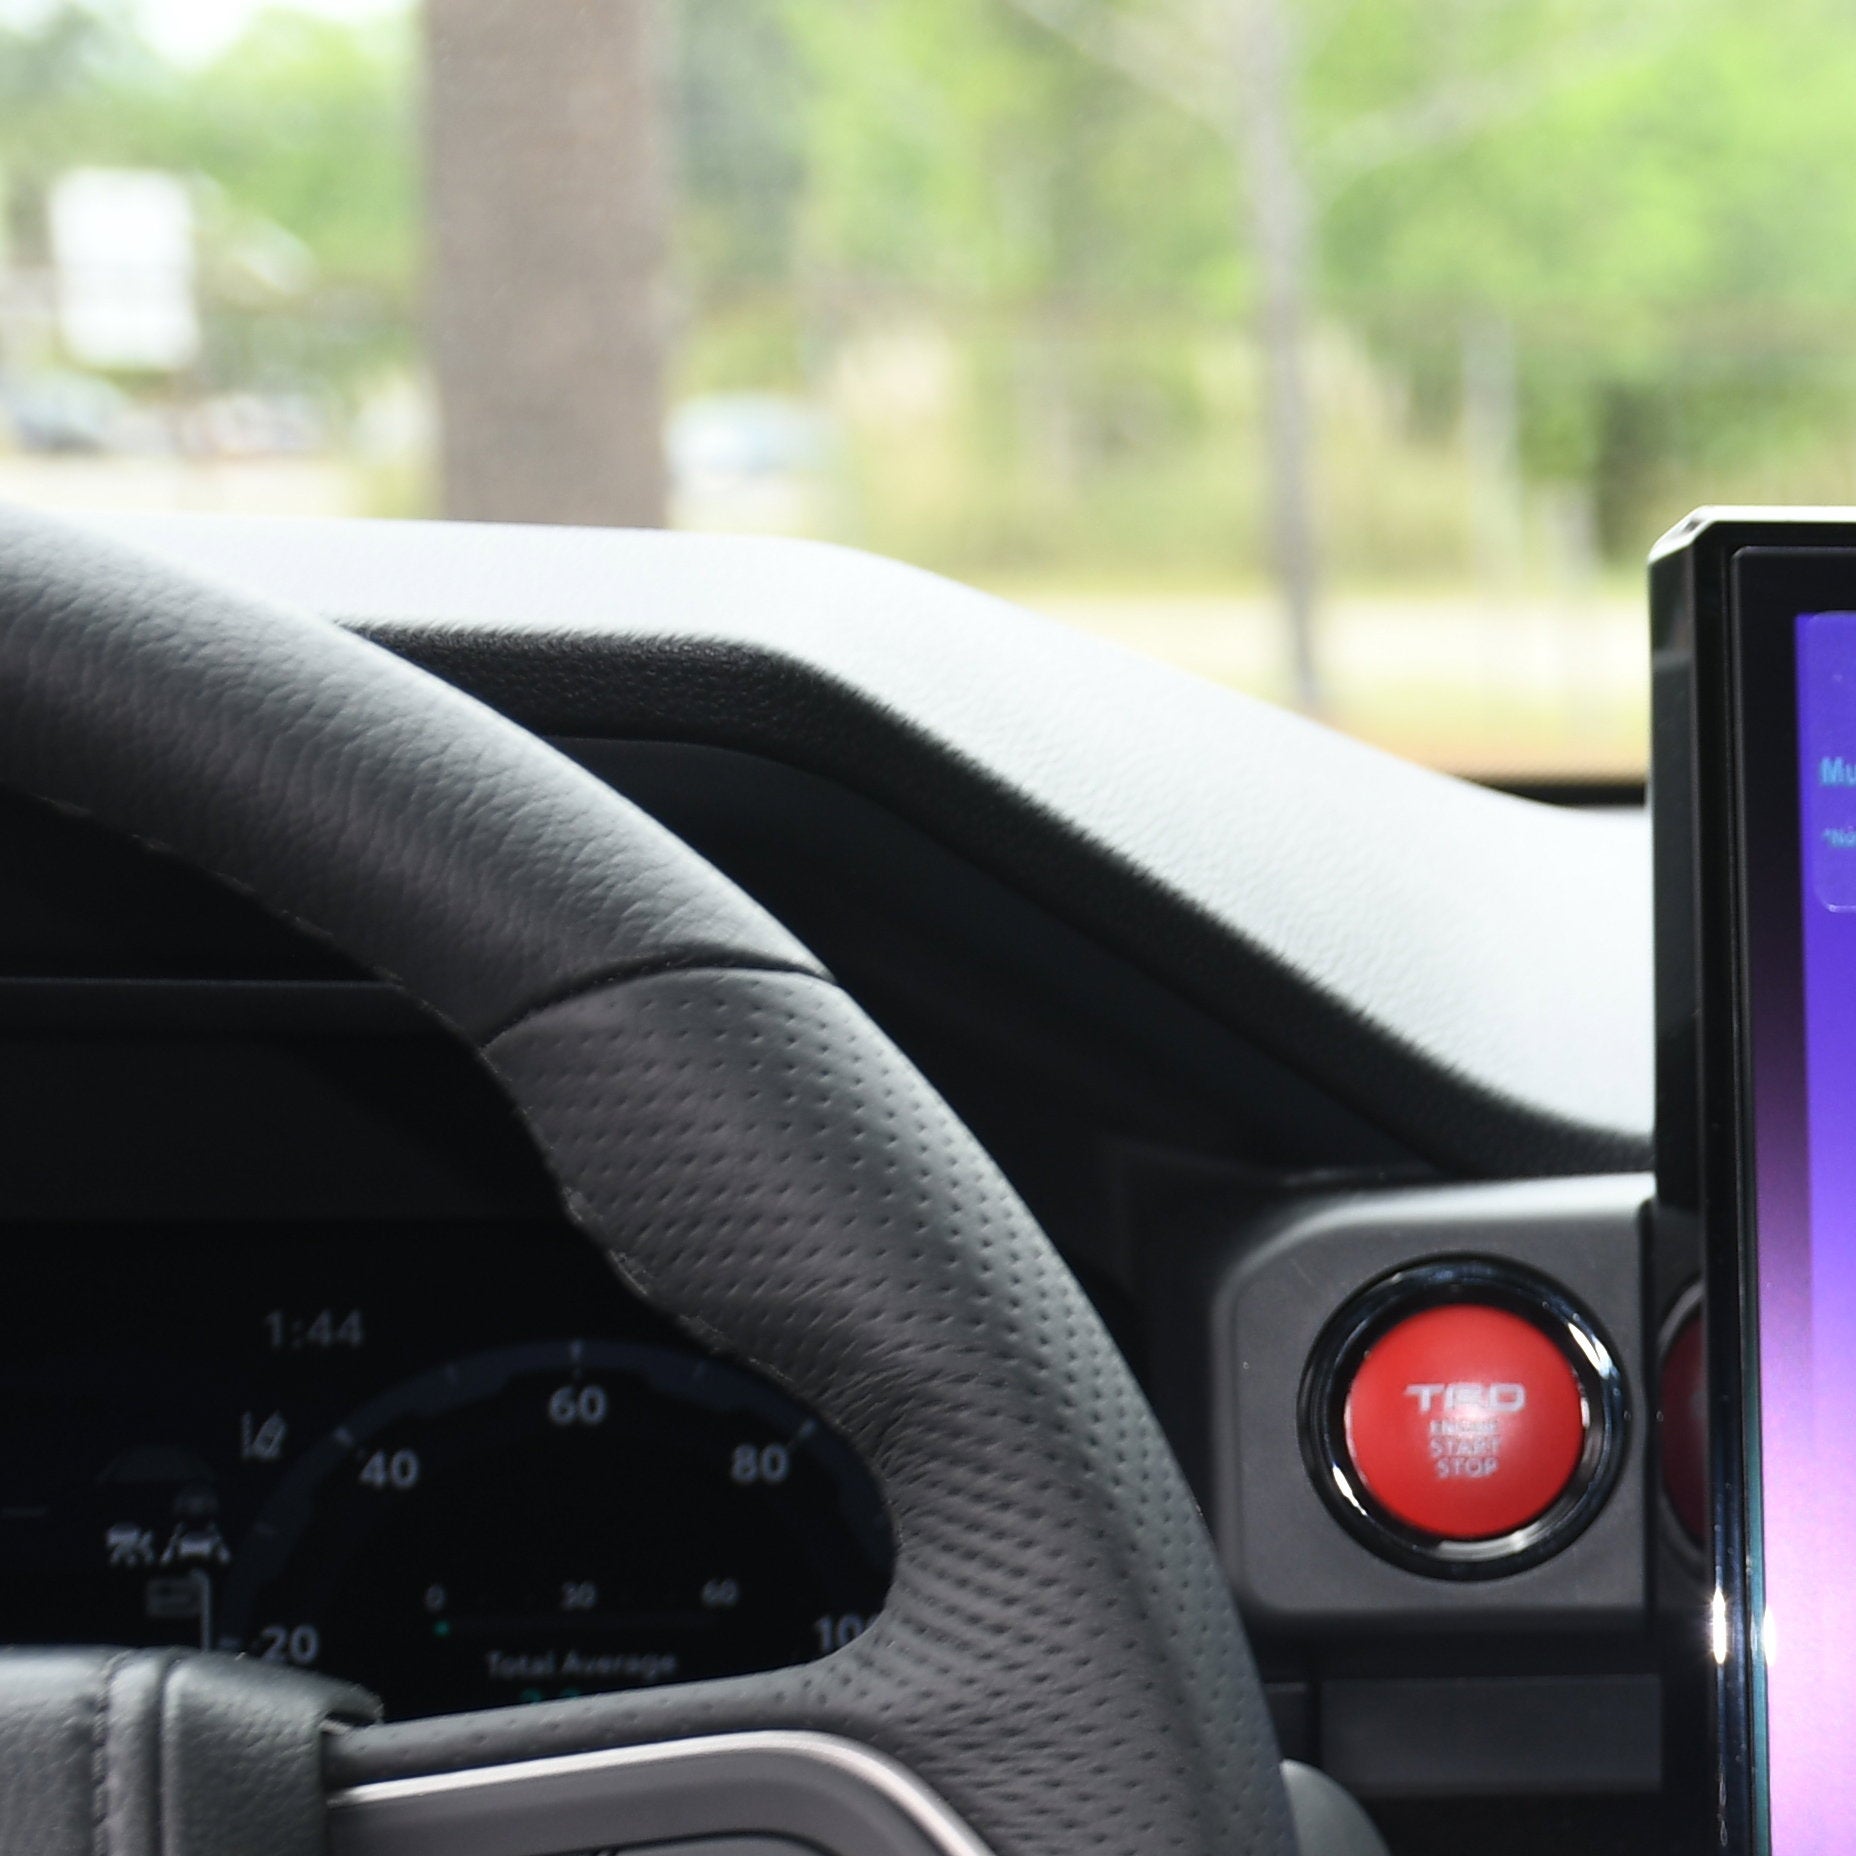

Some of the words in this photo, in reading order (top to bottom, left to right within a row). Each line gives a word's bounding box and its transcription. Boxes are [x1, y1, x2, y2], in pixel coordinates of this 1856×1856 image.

[264, 1308, 366, 1351] 1:44
[547, 1384, 608, 1427] 60
[1404, 1381, 1527, 1413] TRD
[730, 1444, 789, 1486] 80
[1430, 1435, 1501, 1457] START
[358, 1448, 421, 1491] 40
[1436, 1457, 1500, 1479] STOP
[425, 1580, 447, 1613] 0
[701, 1577, 739, 1609] 60
[262, 1622, 320, 1667] 20
[814, 1612, 878, 1653] 10
[487, 1649, 556, 1680] Total
[561, 1647, 679, 1682] Average
